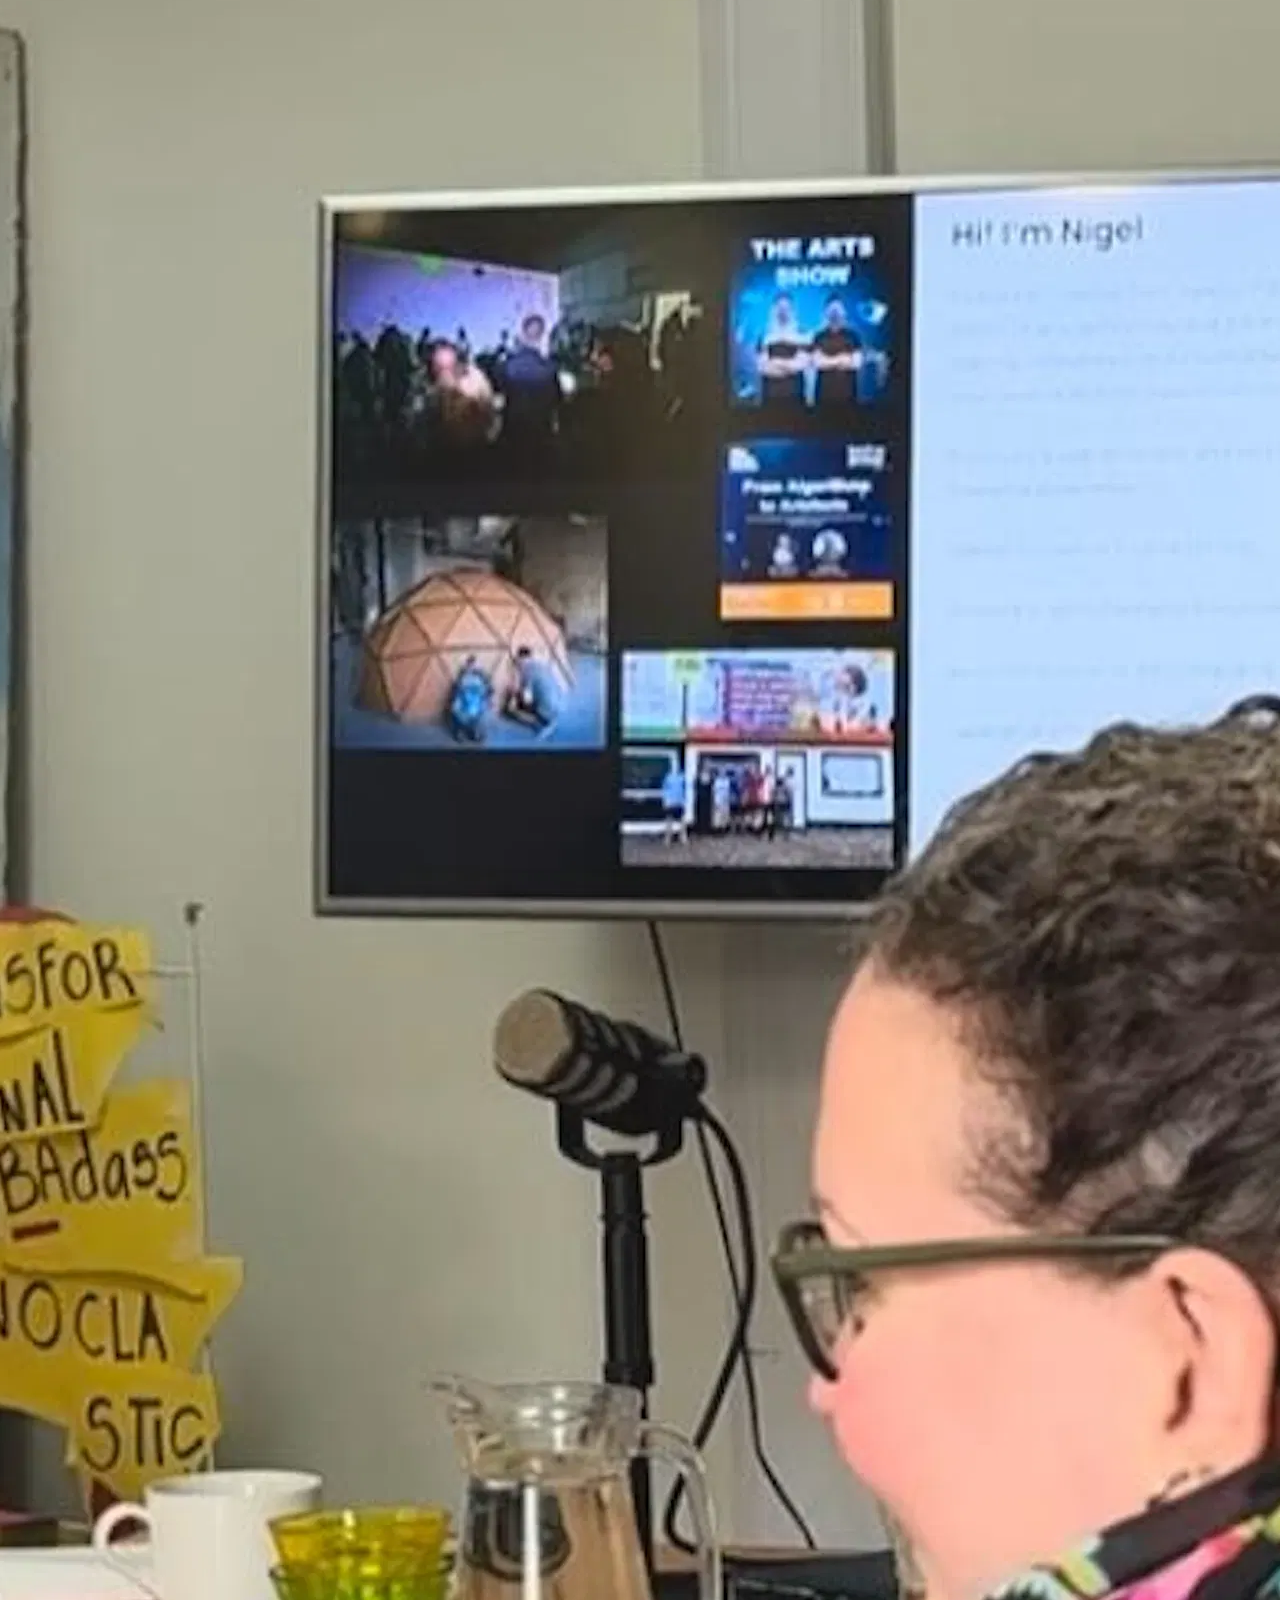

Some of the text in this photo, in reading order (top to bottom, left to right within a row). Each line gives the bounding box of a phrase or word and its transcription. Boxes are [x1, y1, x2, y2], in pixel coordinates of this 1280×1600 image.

[1061, 213, 1145, 253] Nigel
[751, 234, 875, 262] THE ARTS
[775, 264, 852, 288] SHOW
